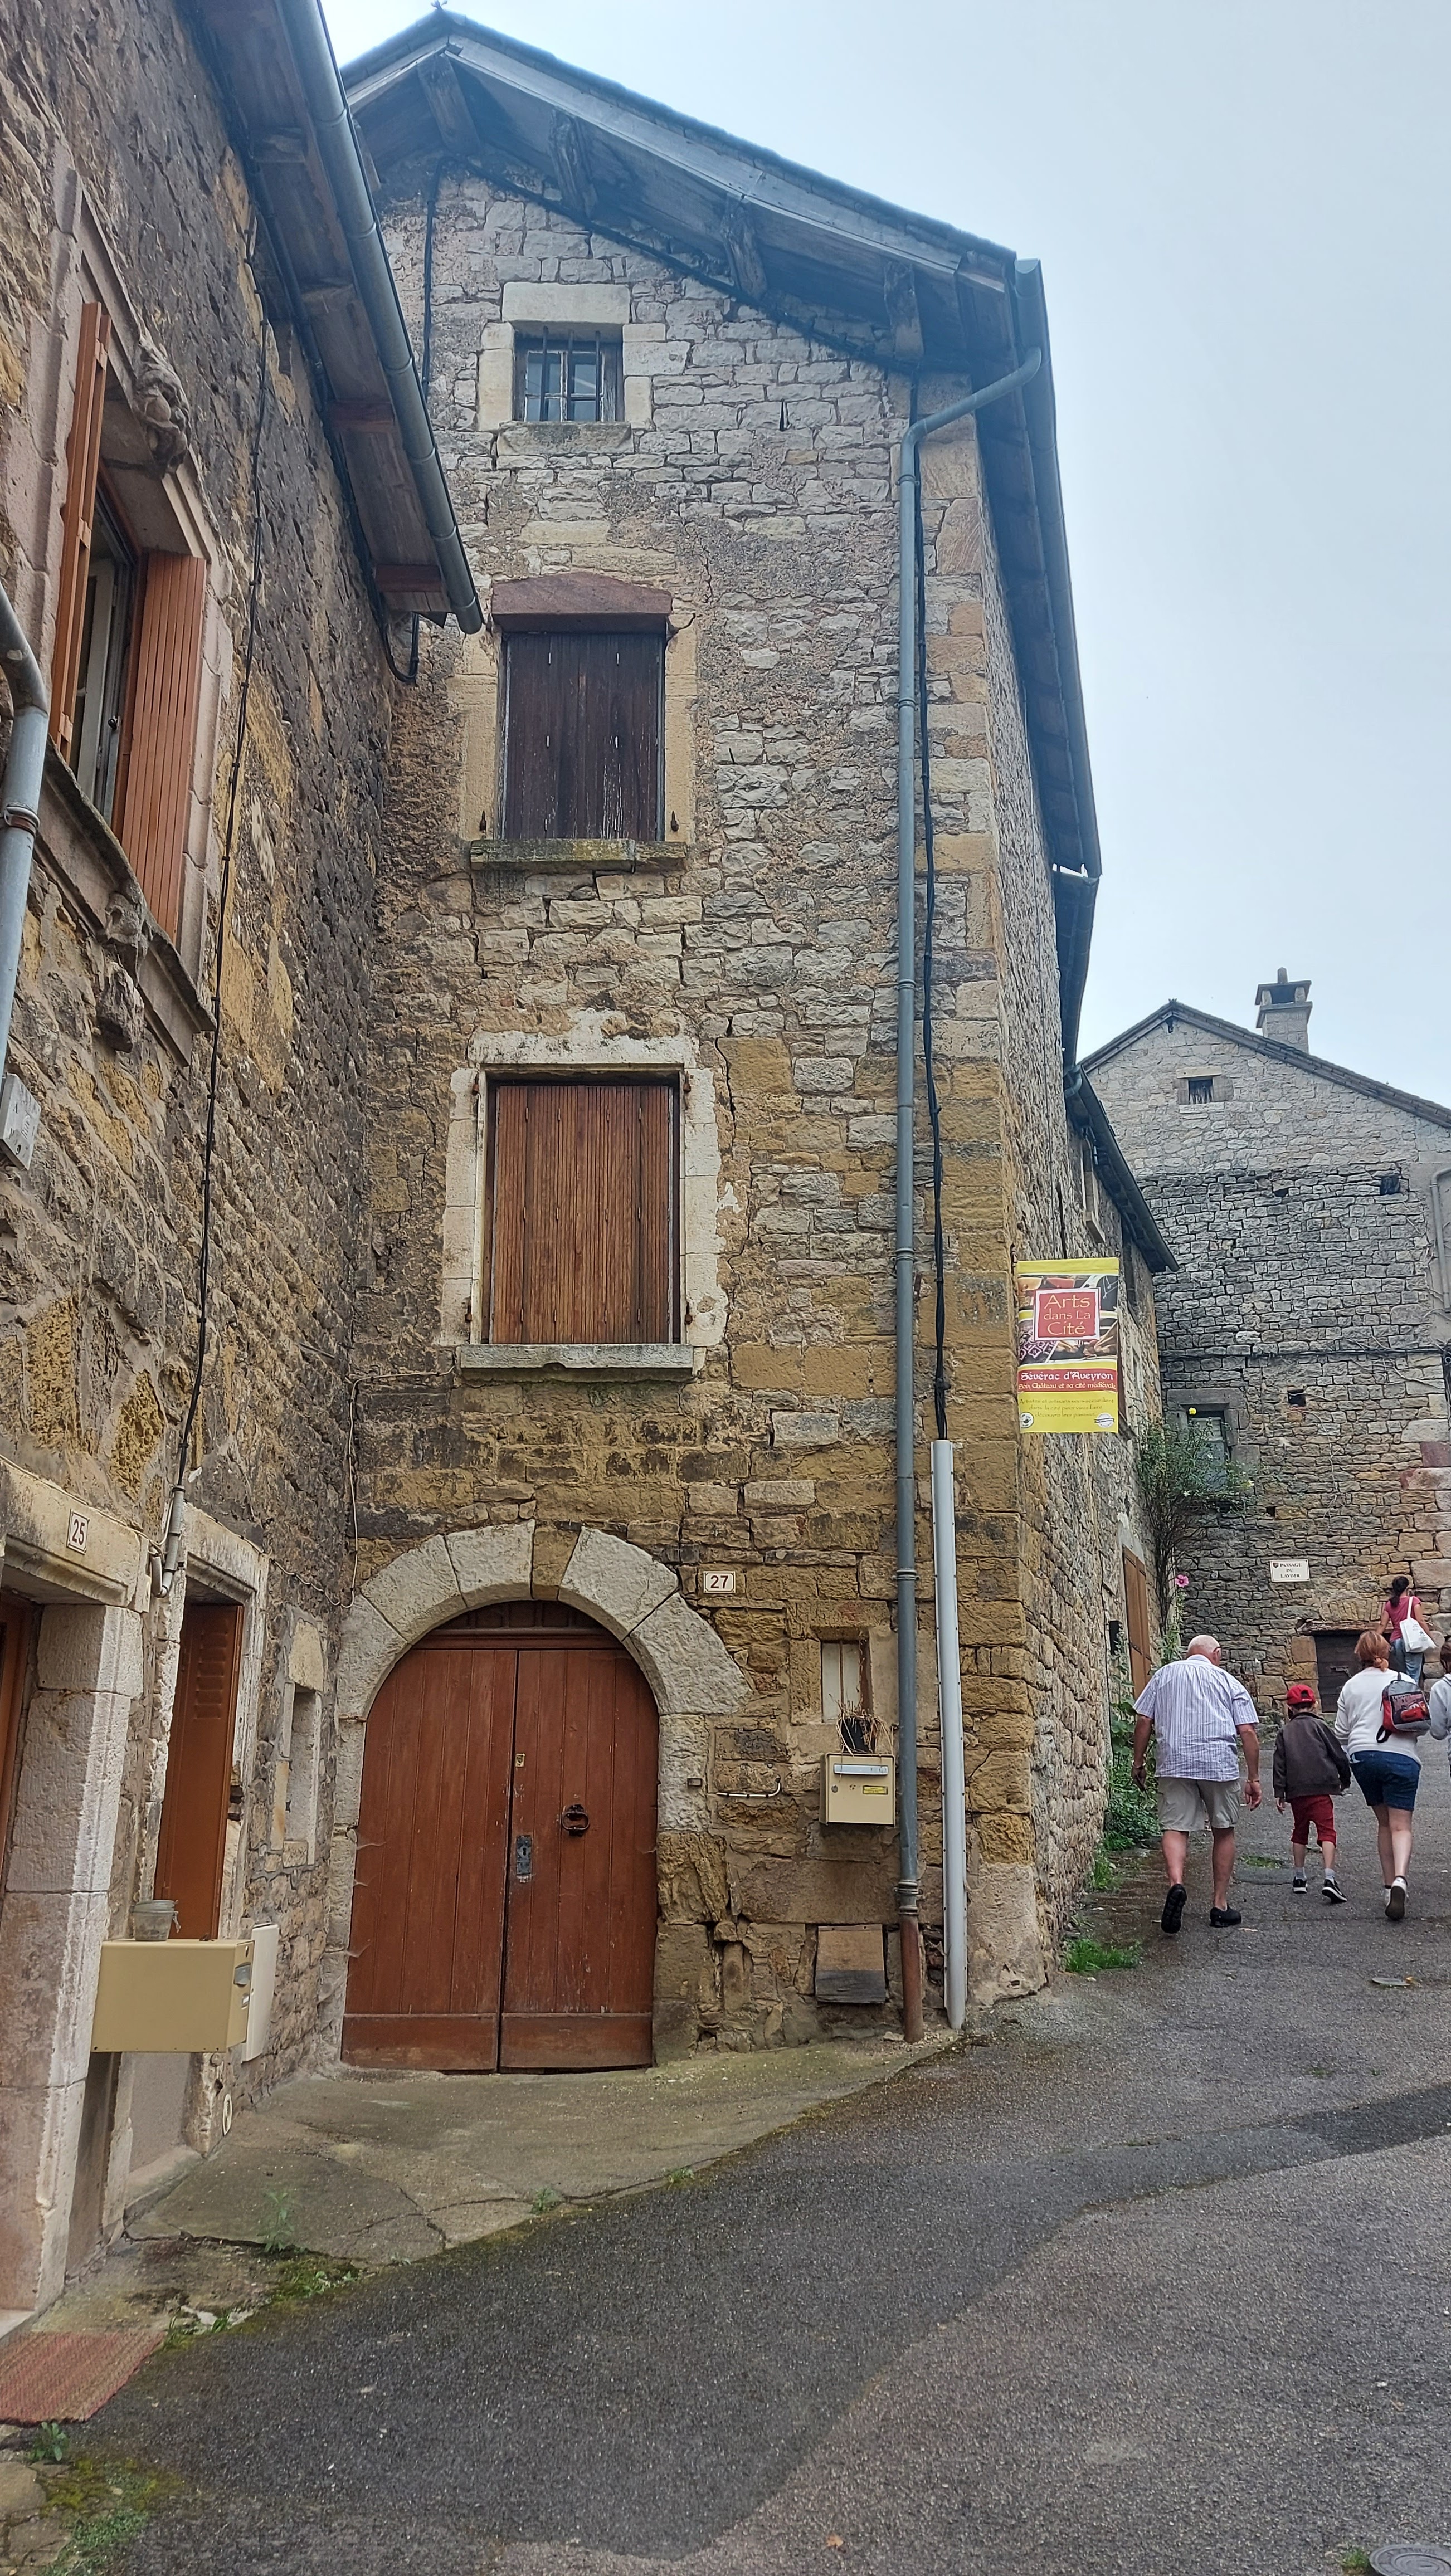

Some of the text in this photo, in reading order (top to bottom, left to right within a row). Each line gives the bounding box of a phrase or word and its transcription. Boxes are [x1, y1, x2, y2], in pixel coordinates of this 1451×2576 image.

[1044, 1295, 1090, 1309] Arts
[1044, 1308, 1090, 1320] dans La
[1048, 1321, 1085, 1335] Cité
[1021, 1371, 1113, 1381] Sévérac d'Aveyron
[72, 1519, 85, 1546] 25
[710, 1575, 729, 1589] 27
